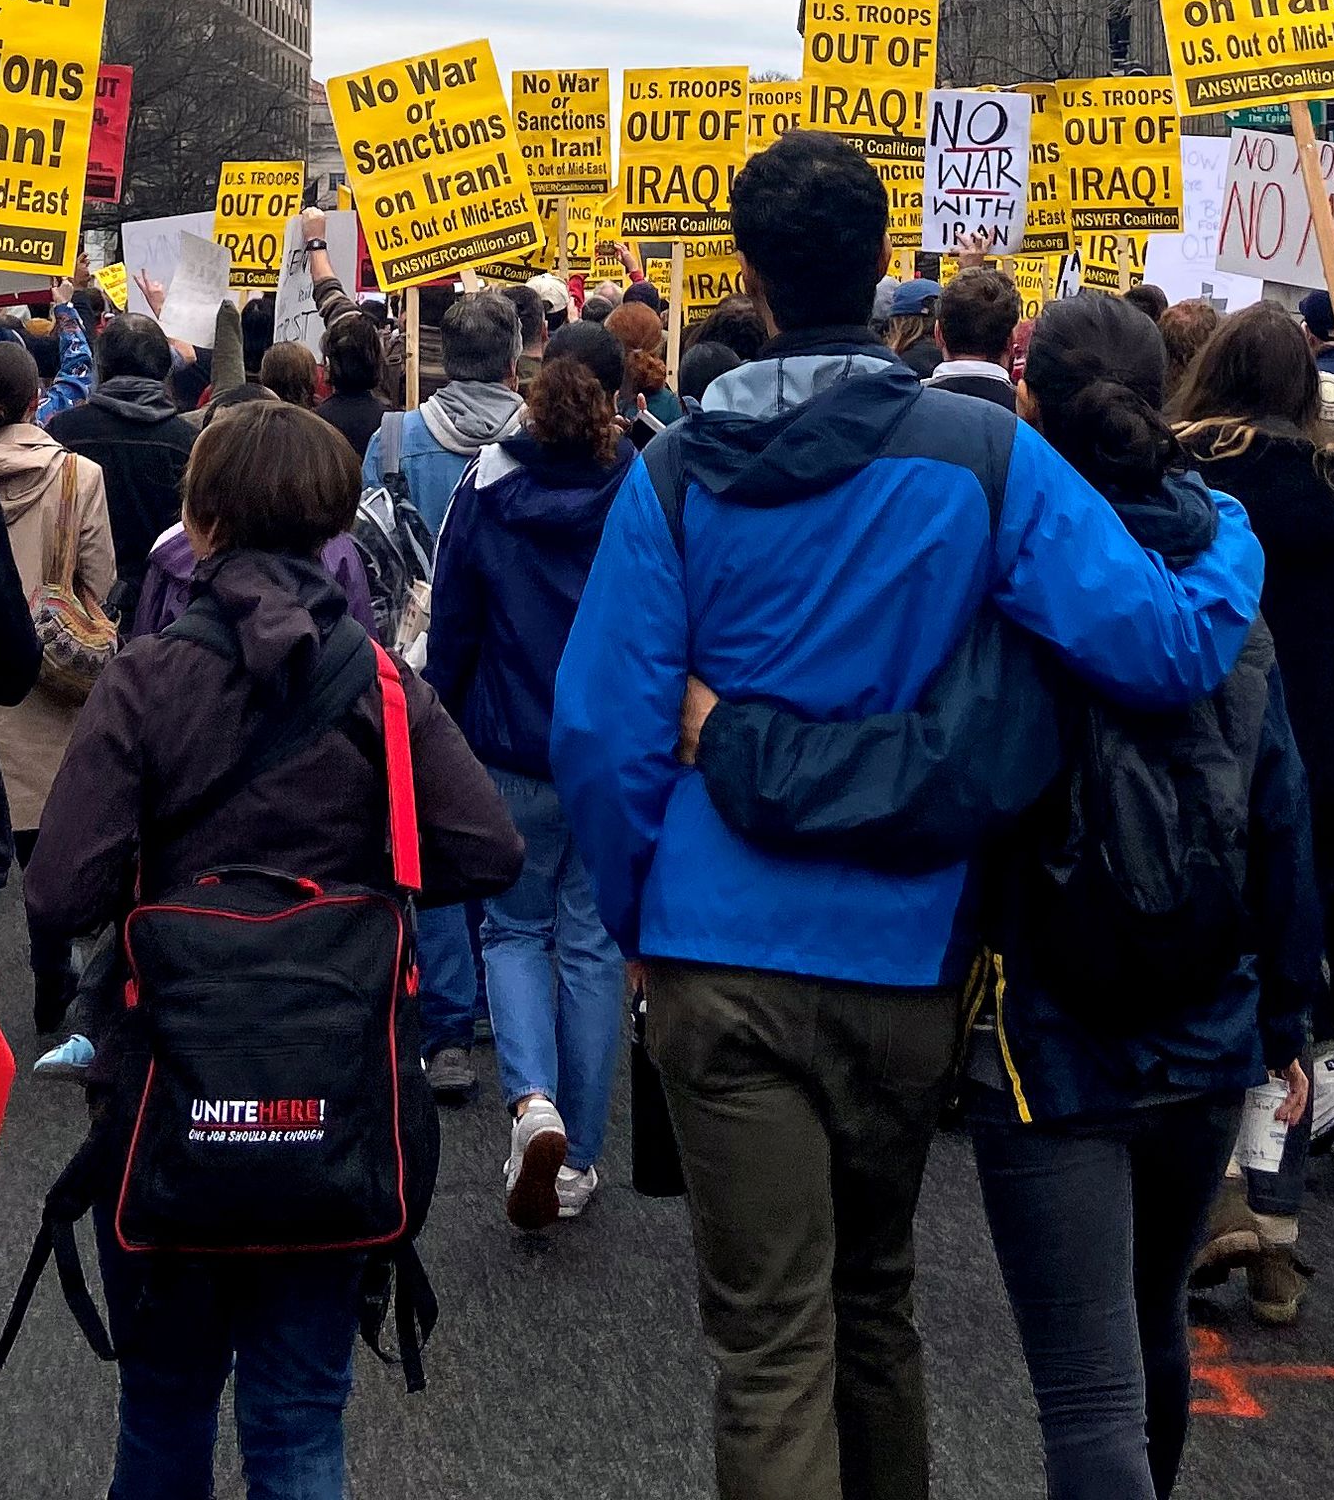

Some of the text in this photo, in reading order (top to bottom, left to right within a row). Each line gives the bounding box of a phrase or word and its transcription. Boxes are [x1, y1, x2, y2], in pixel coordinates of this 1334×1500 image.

[813, 3, 931, 26] U.S. TROOPS
[811, 32, 932, 68] OUT OF
[1182, 41, 1221, 66] U.S.
[1227, 33, 1262, 59] Out
[1268, 28, 1285, 54] of
[96, 77, 120, 98] UT
[347, 57, 477, 113] No War
[523, 74, 599, 94] No War
[629, 80, 741, 100] U.S. TROOPS
[551, 97, 570, 108] or
[748, 92, 802, 105] TROOPS
[1064, 89, 1173, 107] U.S. TROOPS
[407, 99, 436, 125] or
[518, 109, 605, 131] Sanctions
[810, 85, 922, 136] IRAQ!
[1267, 113, 1290, 124] Epiph
[627, 110, 690, 142] OUT
[699, 110, 742, 141] OF
[930, 99, 1008, 148] NO
[1065, 116, 1175, 145] OUT OF
[353, 114, 506, 175] Sanctions
[522, 137, 602, 158] on Iran!
[867, 139, 925, 157] Coalition
[1234, 135, 1275, 172] NO
[225, 172, 299, 185] U.S. TROOPS
[527, 163, 607, 176] S. Out of Mid-East
[938, 149, 1021, 189] WAR
[375, 153, 511, 218] on Iran!
[533, 182, 604, 193] SWERCoalition.org
[627, 164, 735, 211] IRAQ!
[1070, 166, 1170, 206] IRAQ!
[221, 194, 298, 217] OUT OF
[892, 188, 923, 208] Ira
[934, 196, 1015, 219] WITH
[375, 193, 529, 251] U.S. Out of Mid-East
[622, 218, 676, 232] ANSWER
[1028, 209, 1066, 226] d-East
[1124, 212, 1179, 226] Coalition
[1219, 181, 1285, 260] NO
[391, 231, 530, 278] ANSWERCoalition.org
[685, 240, 735, 257] BOMB
[1089, 235, 1148, 267] IRA
[689, 273, 745, 300] IRA
[1017, 276, 1053, 289] MBING
[1087, 269, 1119, 285] ANSW
[688, 308, 717, 320] ANSW
[207, 1130, 226, 1142] JOB
[228, 1130, 266, 1142] SHOULD
[268, 1130, 282, 1141] BE
[284, 1130, 325, 1141] ENOUGH
